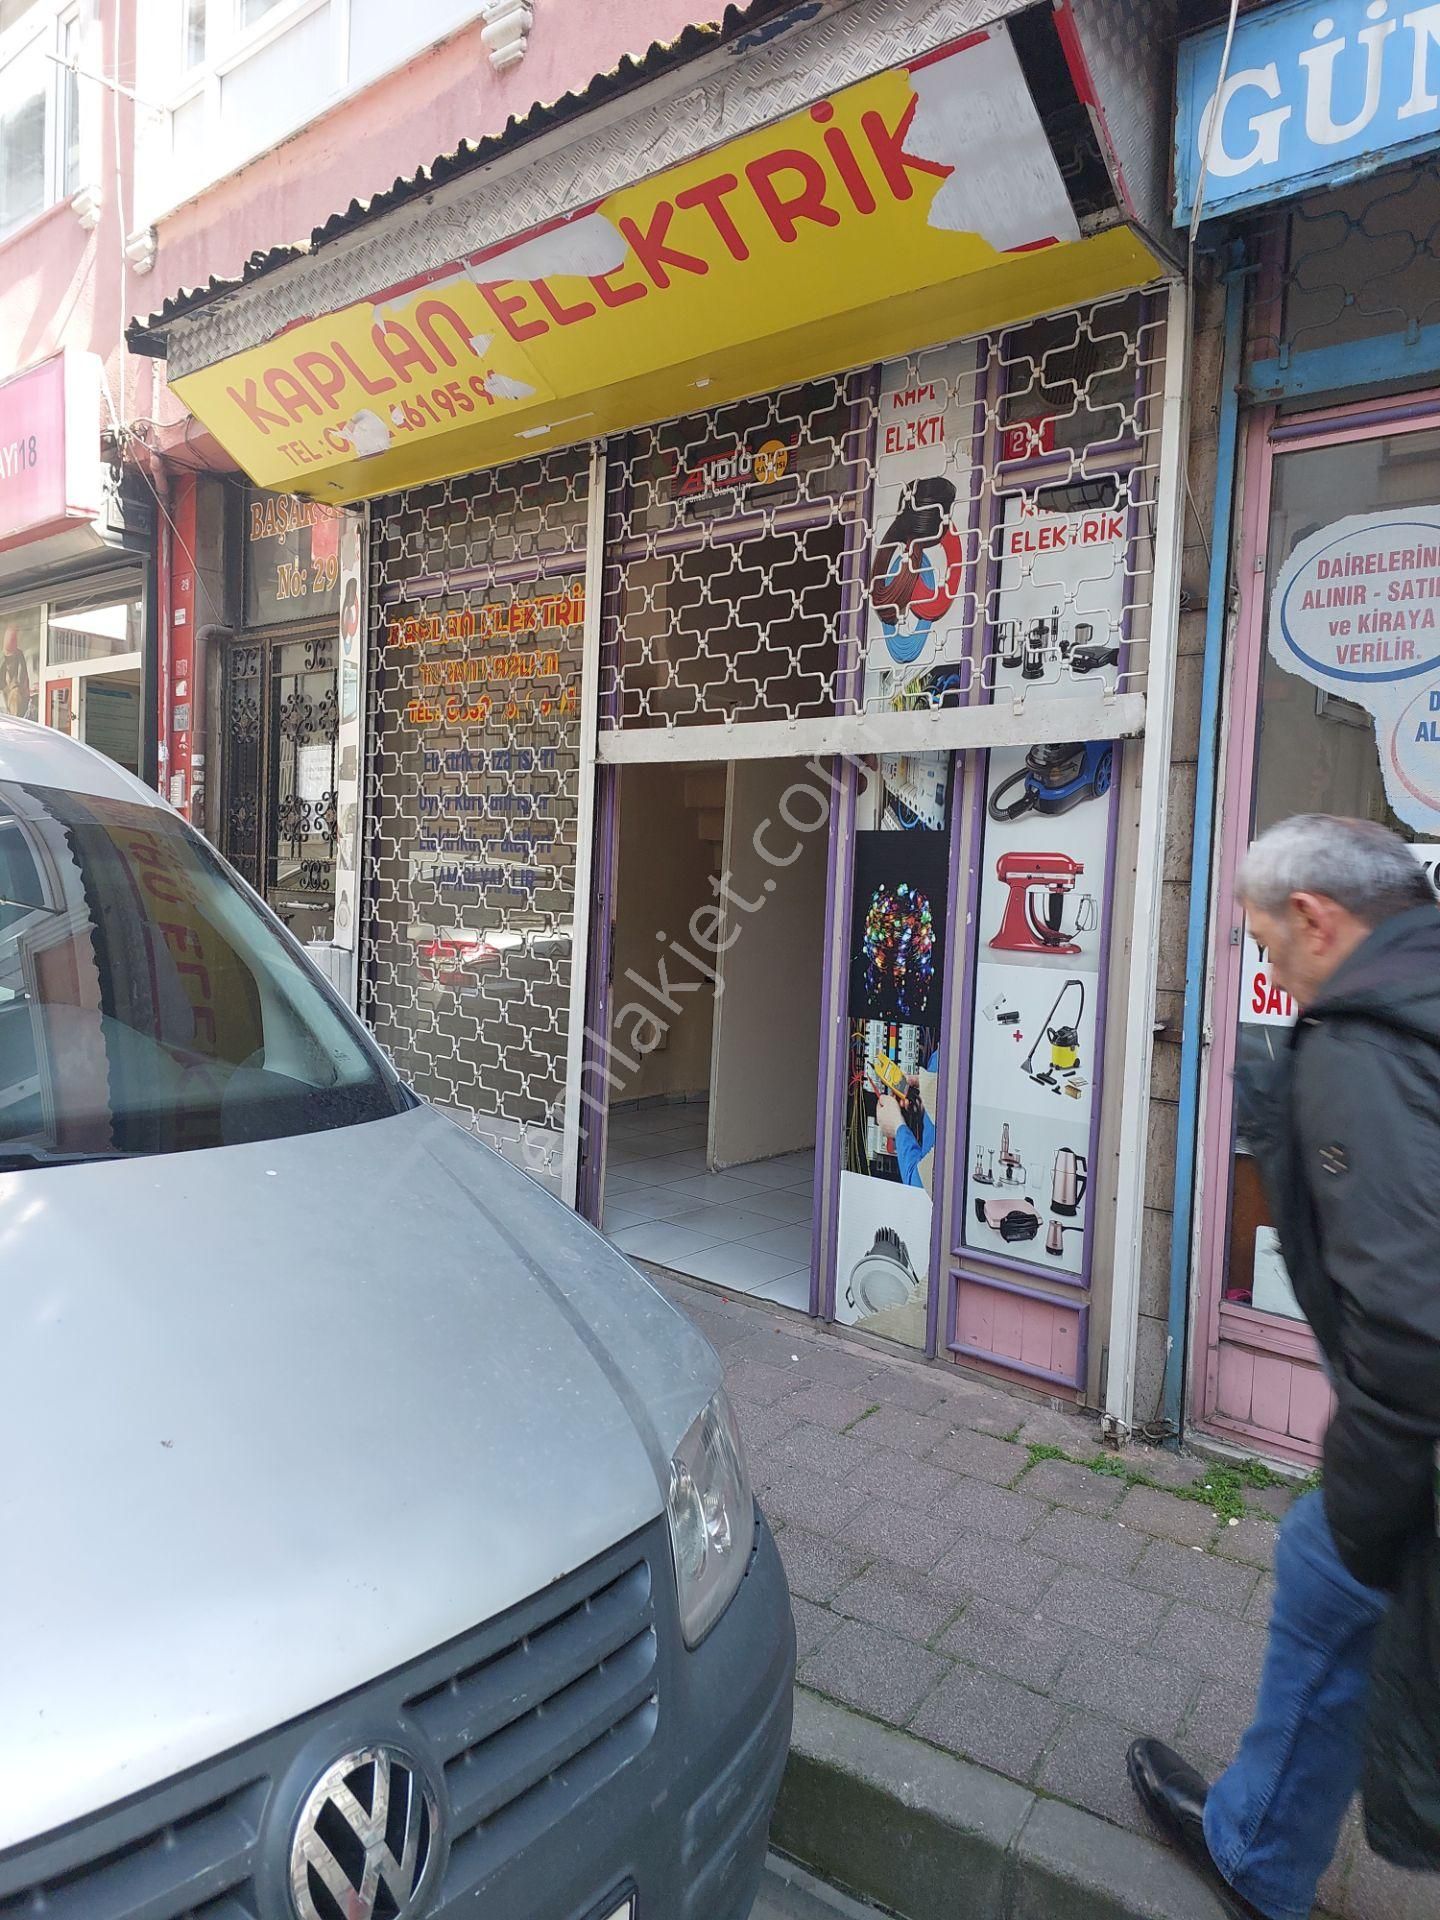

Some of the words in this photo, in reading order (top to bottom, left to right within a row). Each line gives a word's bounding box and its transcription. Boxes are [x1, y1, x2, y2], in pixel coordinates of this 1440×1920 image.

[226, 299, 482, 435] KAPLAN
[476, 92, 956, 342] ELEKTRİK
[312, 553, 339, 593] 29
[481, 582, 586, 642] ELEKTRİ
[1301, 584, 1367, 610] ALINIR
[1328, 619, 1352, 637] ve
[1357, 608, 1436, 634] KİRAYA
[1335, 635, 1424, 665] VERİLİR.
